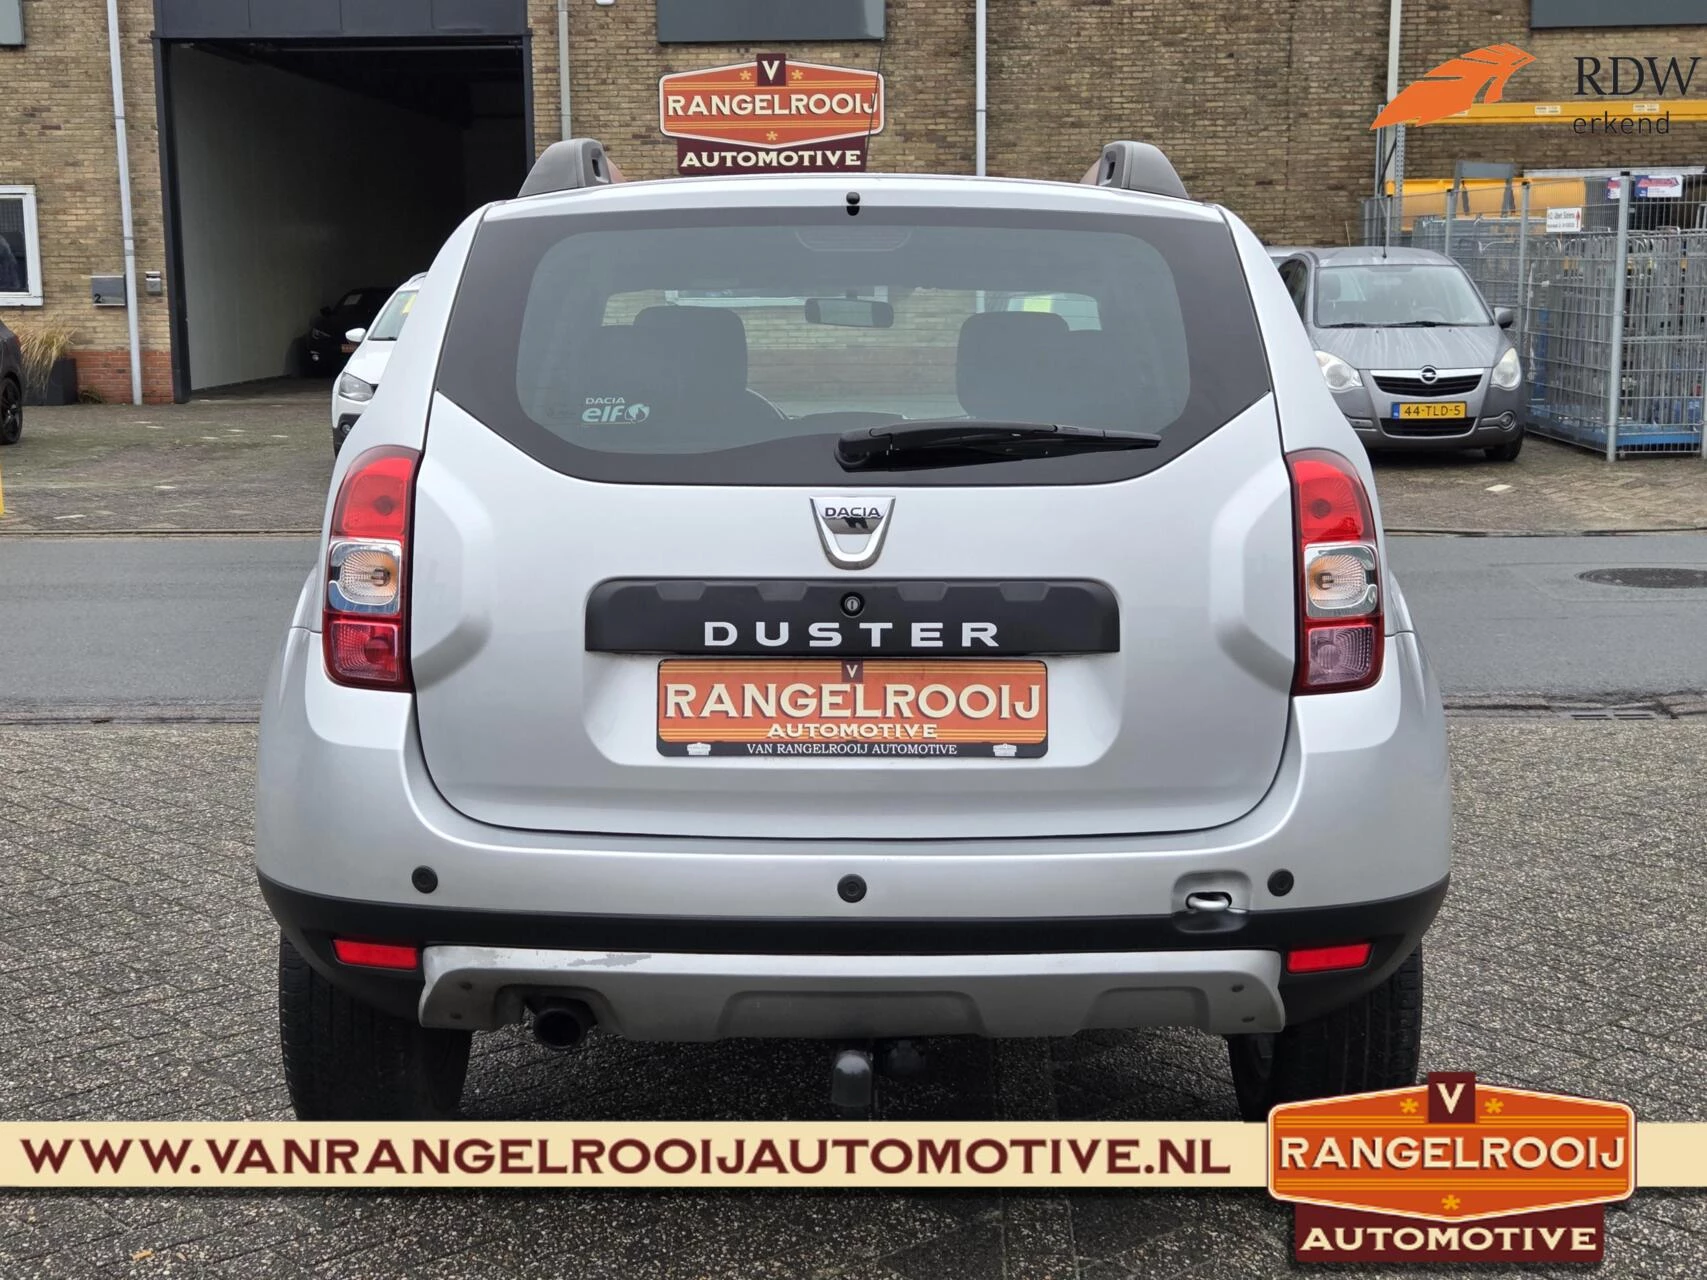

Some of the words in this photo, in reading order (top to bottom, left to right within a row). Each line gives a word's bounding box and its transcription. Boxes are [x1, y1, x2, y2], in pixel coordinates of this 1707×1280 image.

[761, 60, 781, 82] V
[667, 92, 878, 116] RANGELROOIJ
[680, 149, 861, 168] AUTOMOTIVE
[585, 397, 626, 405] DACIA
[582, 405, 625, 422] elf
[1404, 405, 1461, 417] 44-TLD-5
[824, 507, 881, 517] DACIA
[703, 621, 1000, 648] DUSTER
[846, 664, 859, 678] V
[665, 683, 1041, 719] RANGELROOIJ
[767, 723, 938, 738] AUTOMOTIVE
[747, 743, 774, 754] VAN
[777, 743, 868, 755] RANGELROOIJ
[872, 744, 958, 755] AUTOMOTIVE
